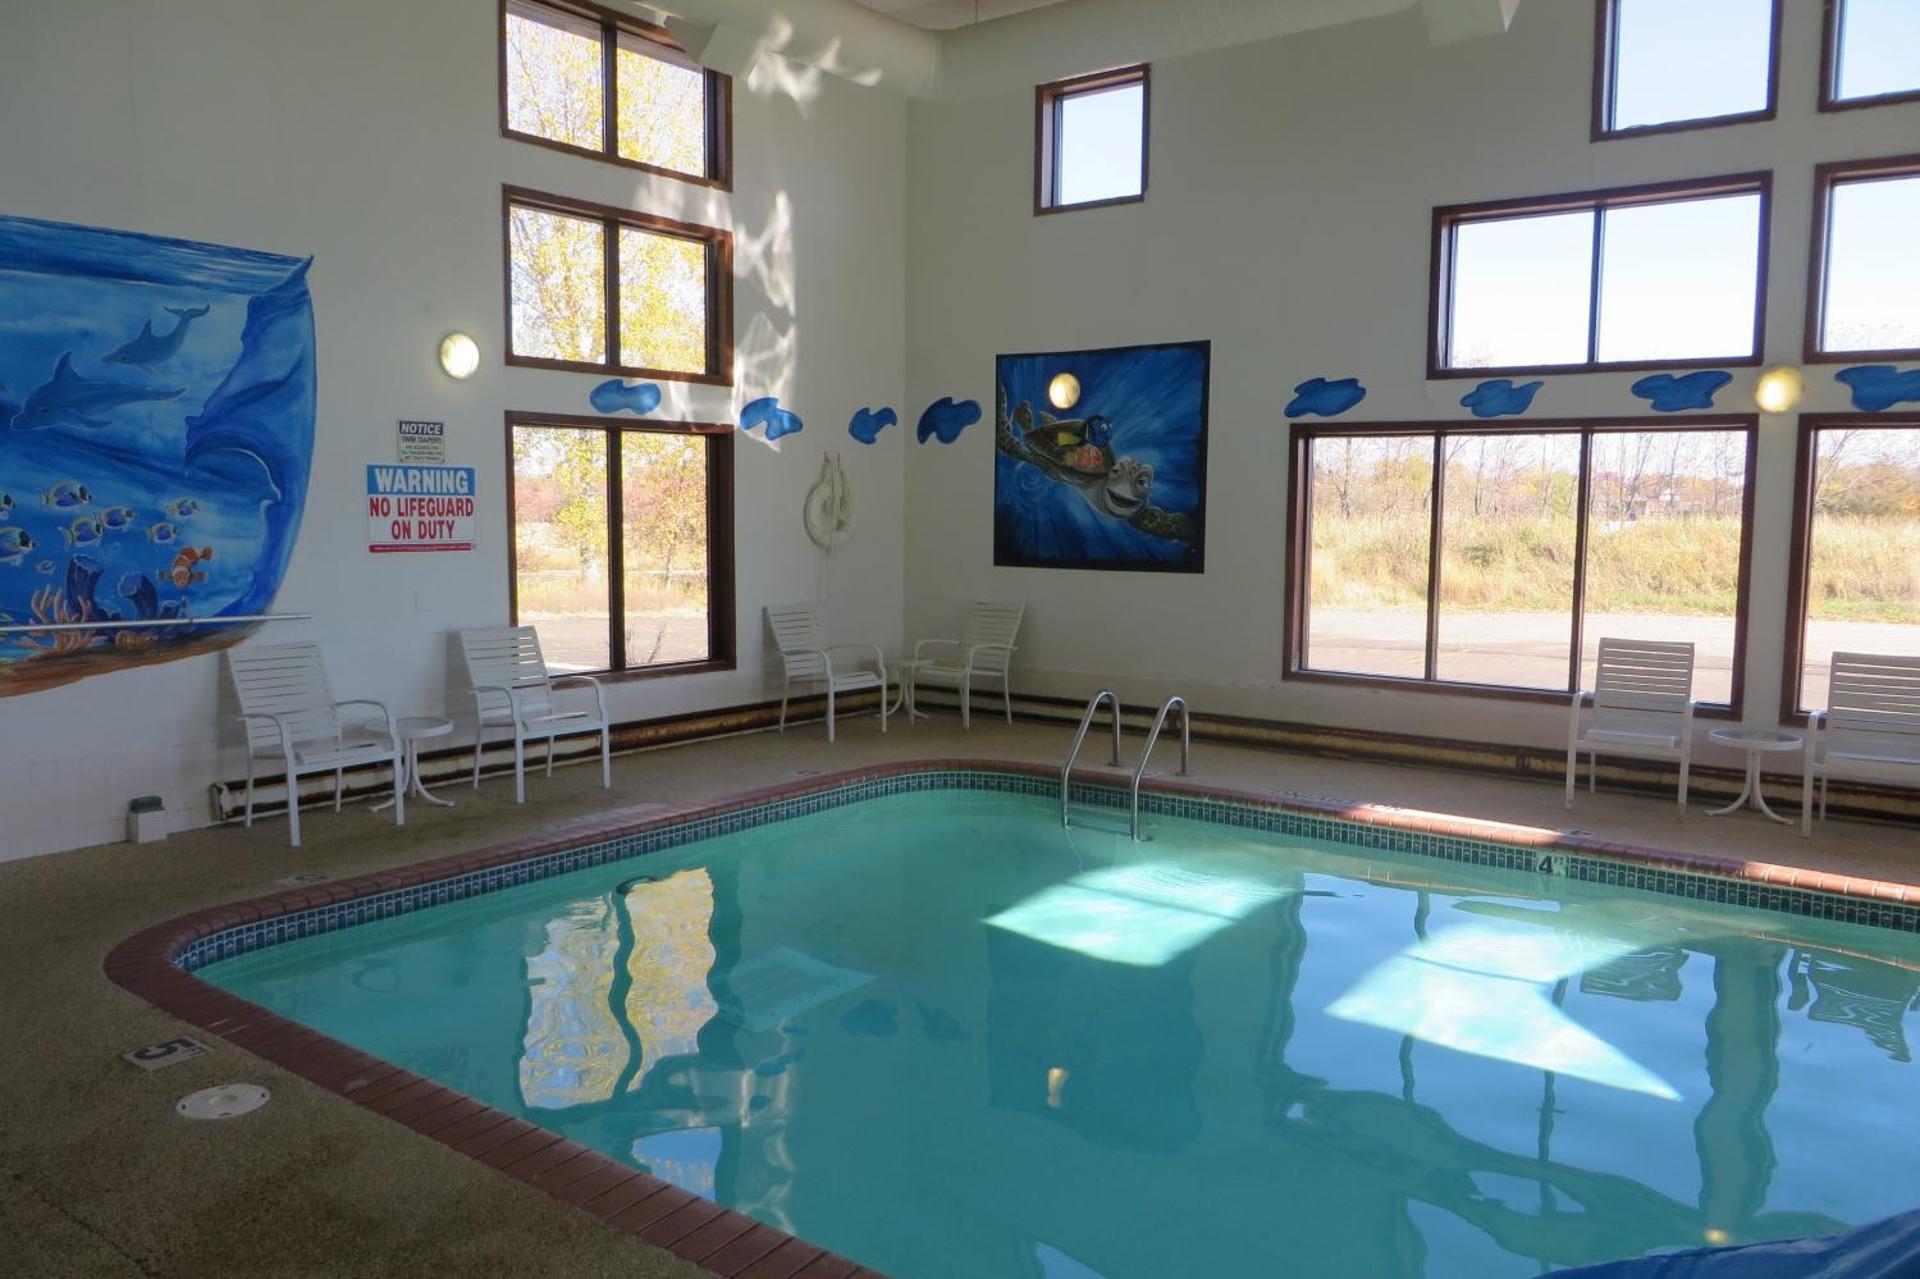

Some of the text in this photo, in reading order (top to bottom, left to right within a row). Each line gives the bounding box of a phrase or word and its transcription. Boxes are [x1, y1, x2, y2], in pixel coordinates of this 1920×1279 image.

[401, 423, 441, 435] NOTICE
[374, 468, 469, 494] WARNING
[369, 497, 474, 517] NO LIFEGUARD
[391, 520, 455, 540] ON DUTY
[1539, 855, 1554, 874] 4
[134, 1038, 196, 1060] 5
